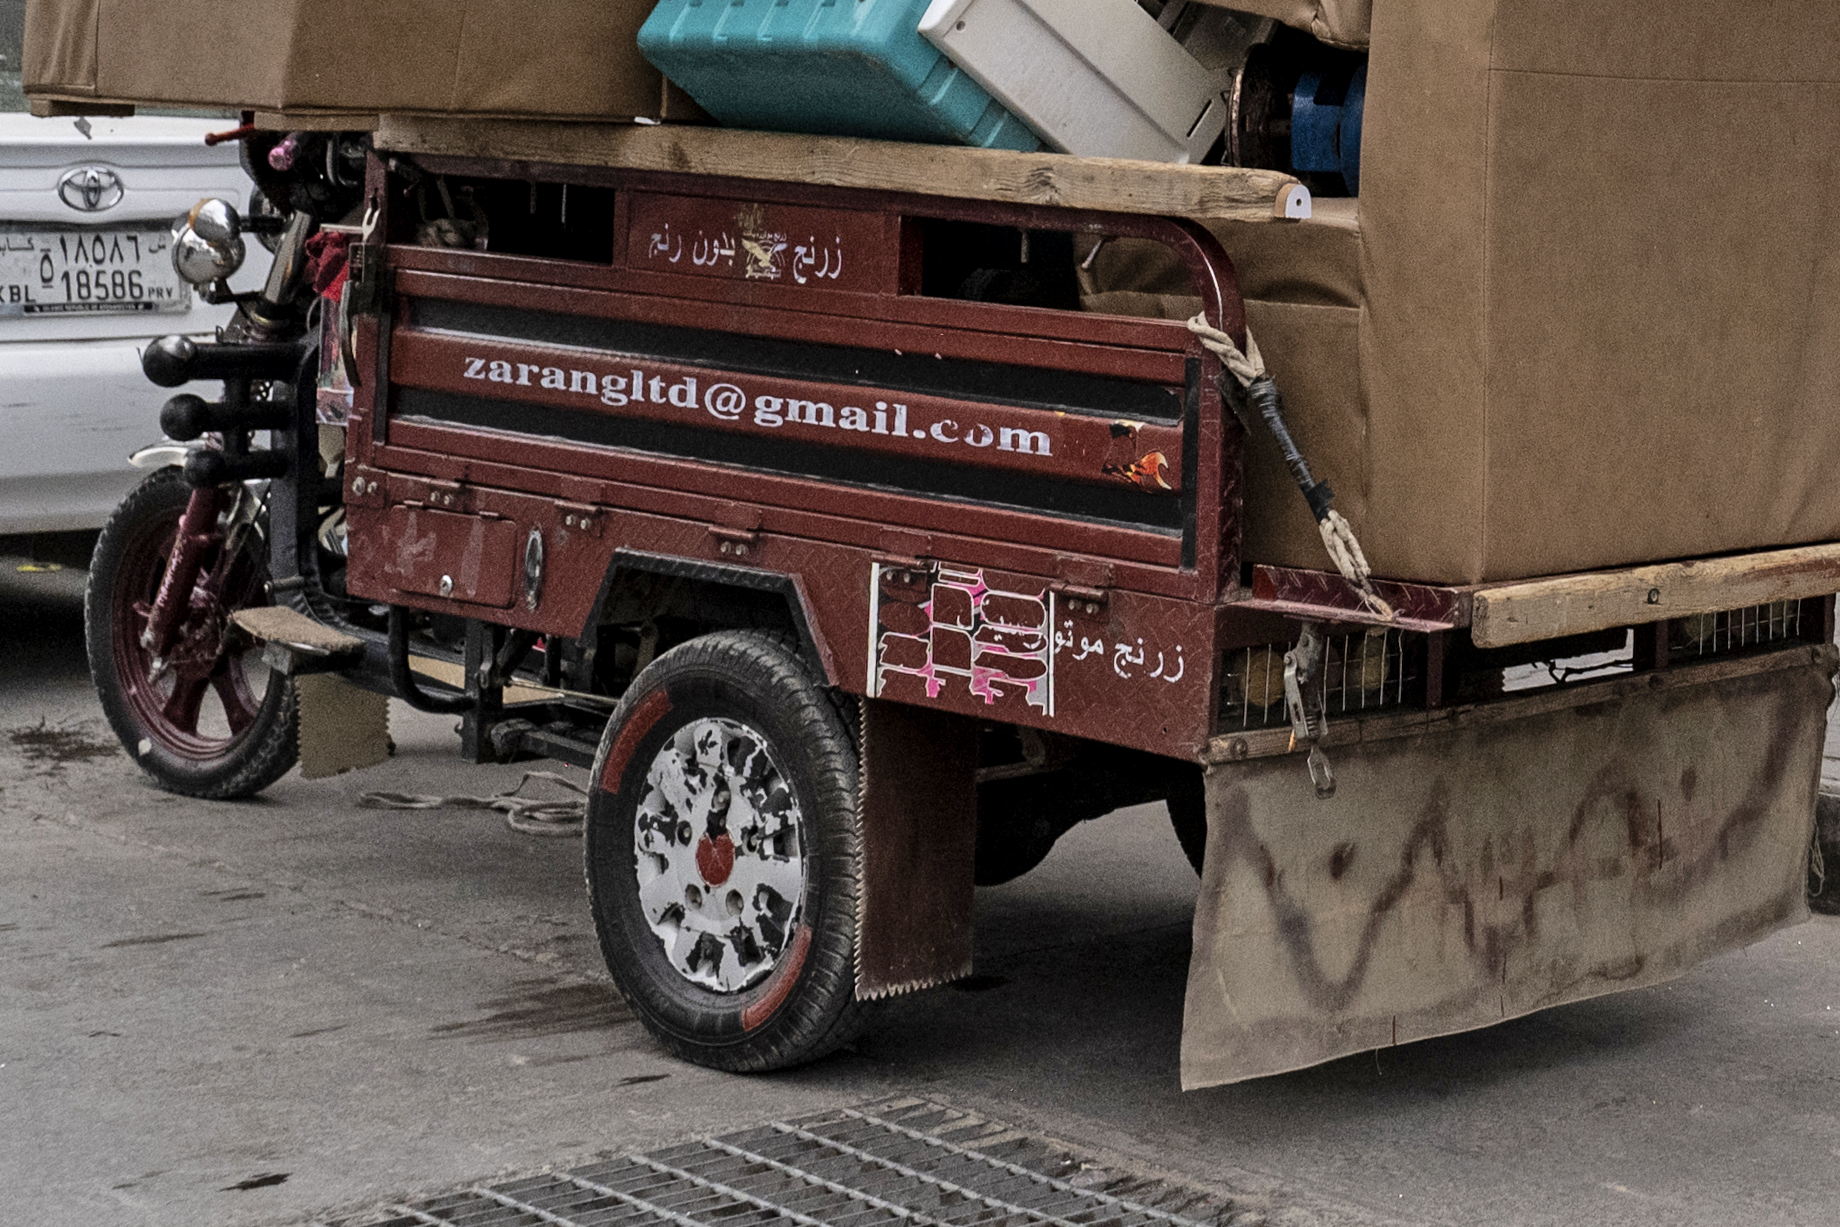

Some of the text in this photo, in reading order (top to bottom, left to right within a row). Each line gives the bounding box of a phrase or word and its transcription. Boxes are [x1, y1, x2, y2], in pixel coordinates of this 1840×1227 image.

[791, 235, 843, 285] زرنج
[61, 269, 145, 302] 18586
[147, 286, 174, 300] PRV
[463, 354, 1054, 458] zarangltd@gmail.com
[1113, 636, 1185, 684] زرنج
